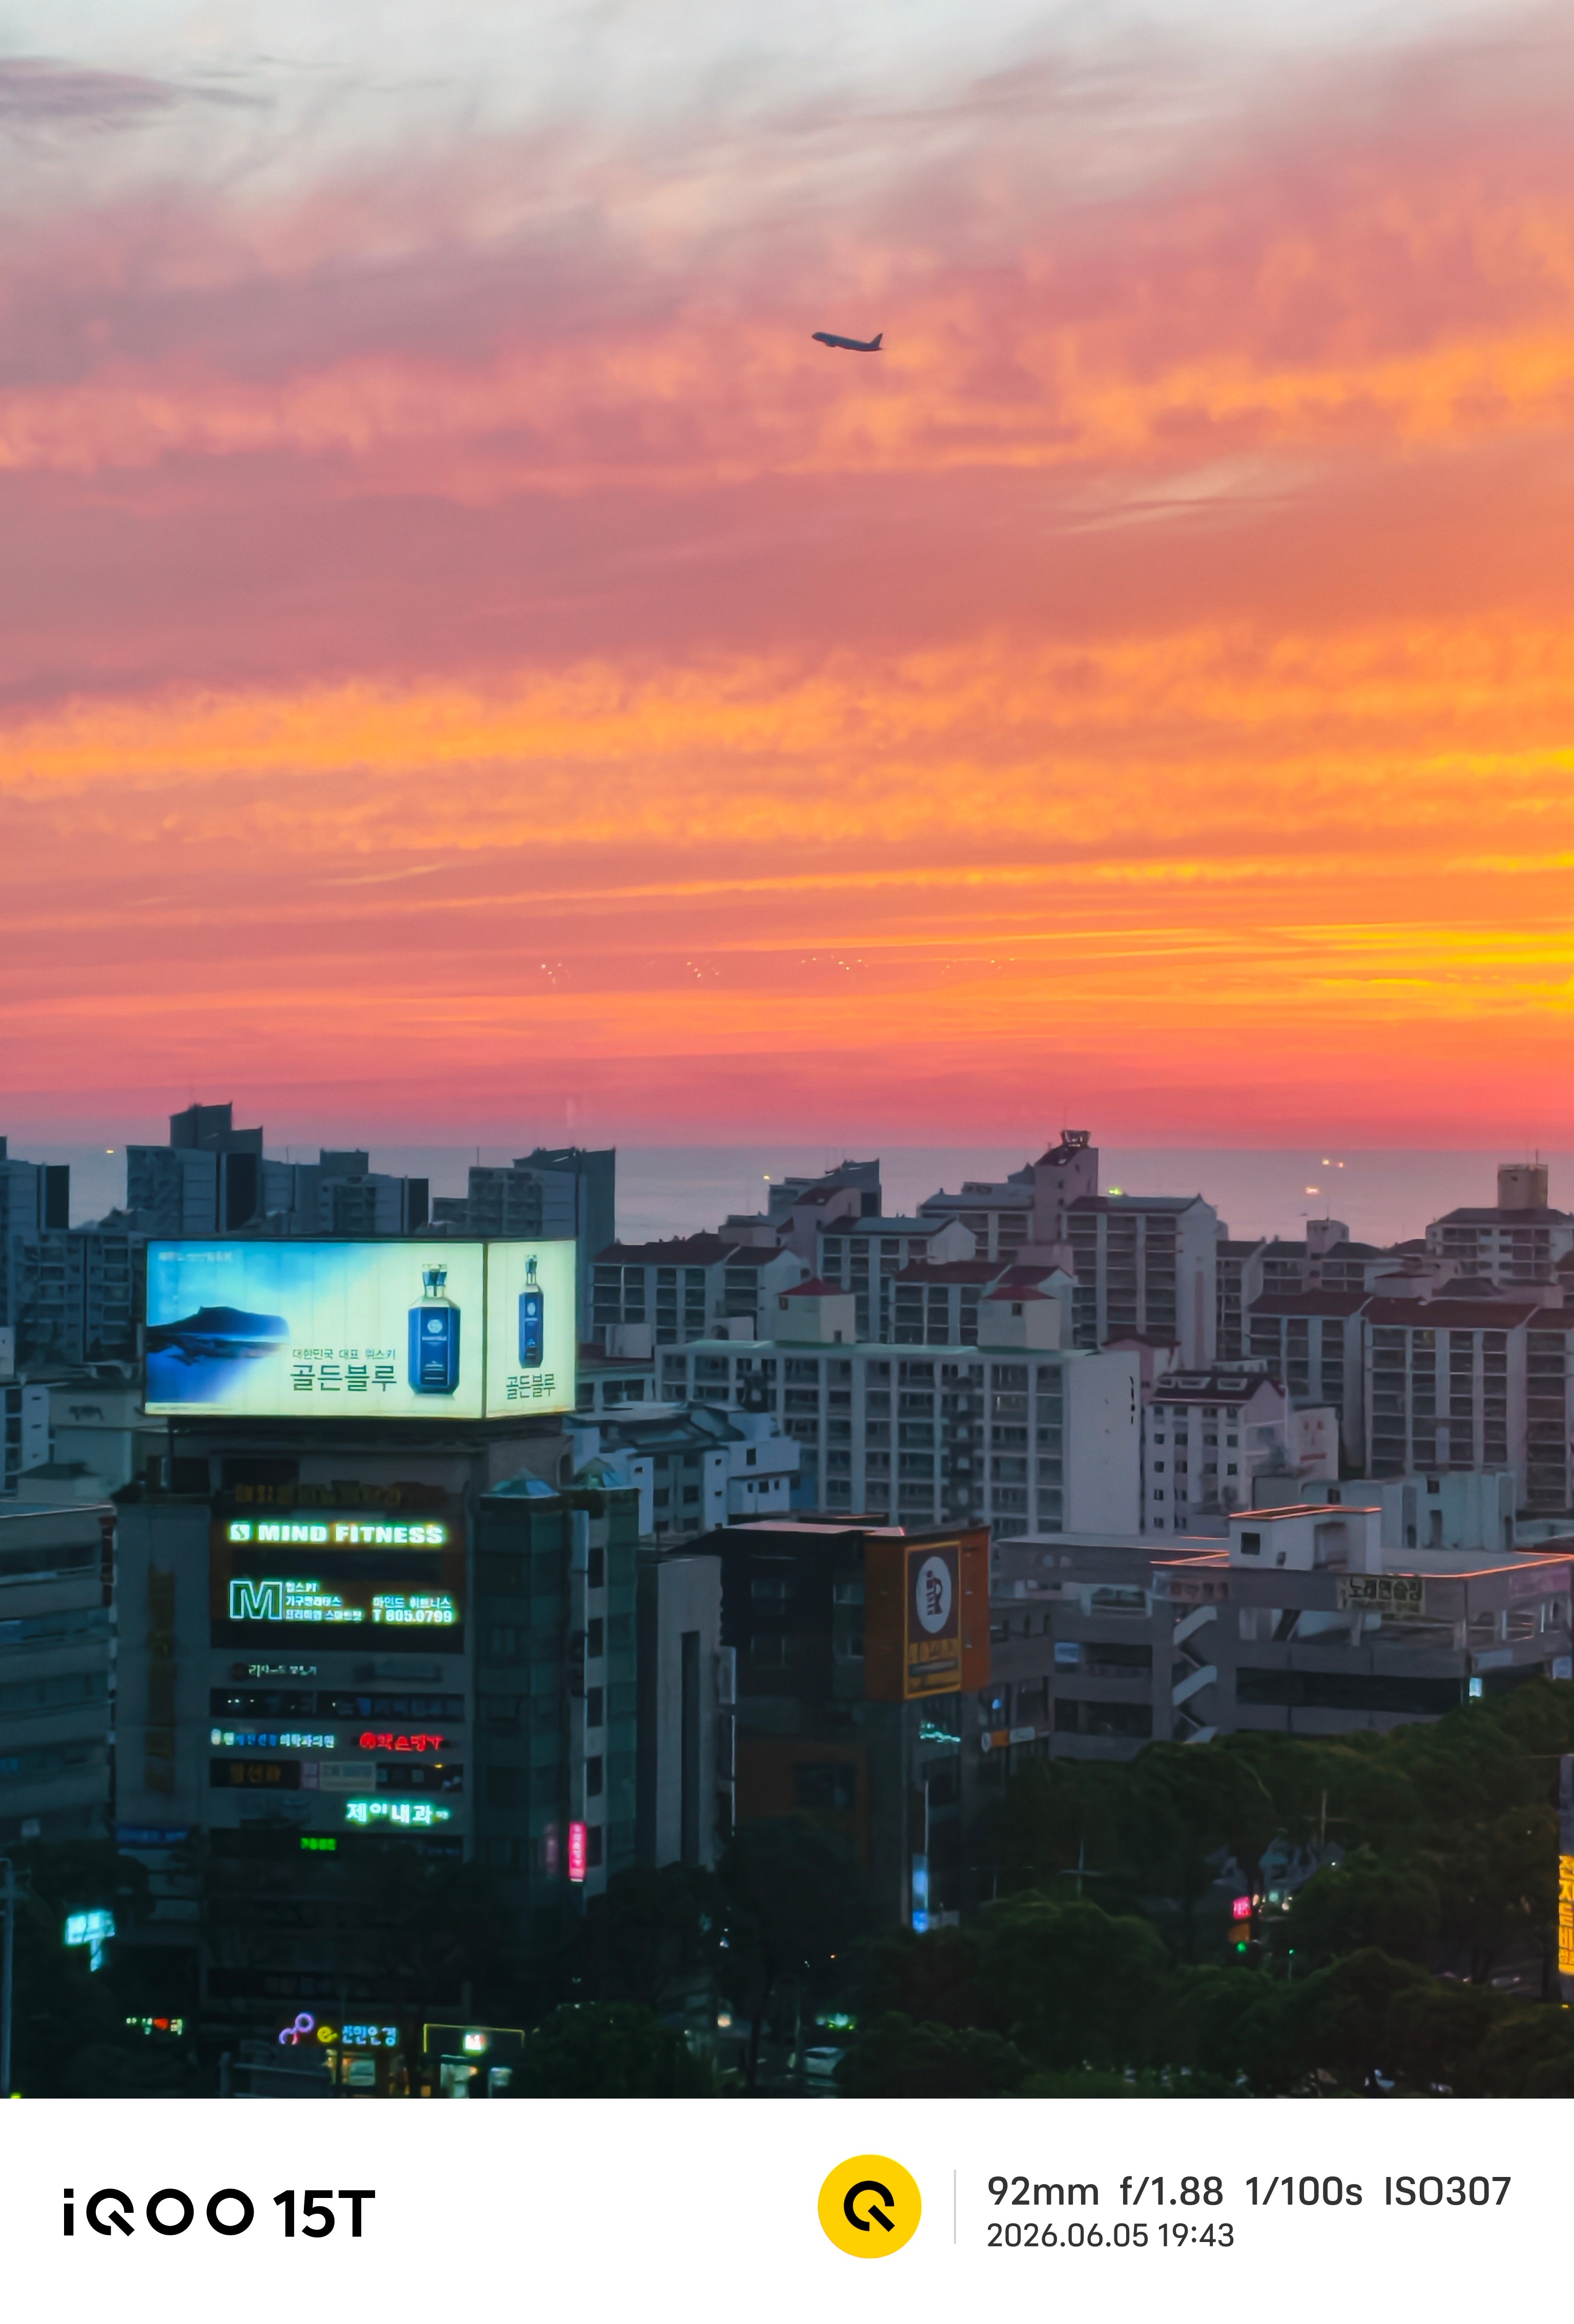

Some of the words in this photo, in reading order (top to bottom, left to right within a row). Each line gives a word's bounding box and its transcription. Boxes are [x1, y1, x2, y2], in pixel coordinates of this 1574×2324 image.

[293, 1348, 333, 1360] 대한민국
[339, 1349, 360, 1360] 대표
[365, 1348, 396, 1360] 위스키
[290, 1364, 397, 1392] 골든블루
[506, 1373, 556, 1400] 골든블루
[258, 1524, 327, 1542] MIND
[335, 1525, 444, 1544] FITNESS
[229, 1580, 283, 1621] M
[372, 1596, 405, 1609] 마인드
[372, 1609, 382, 1622] T
[385, 1609, 453, 1623] 805.0799
[346, 1802, 433, 1824] 제이내과
